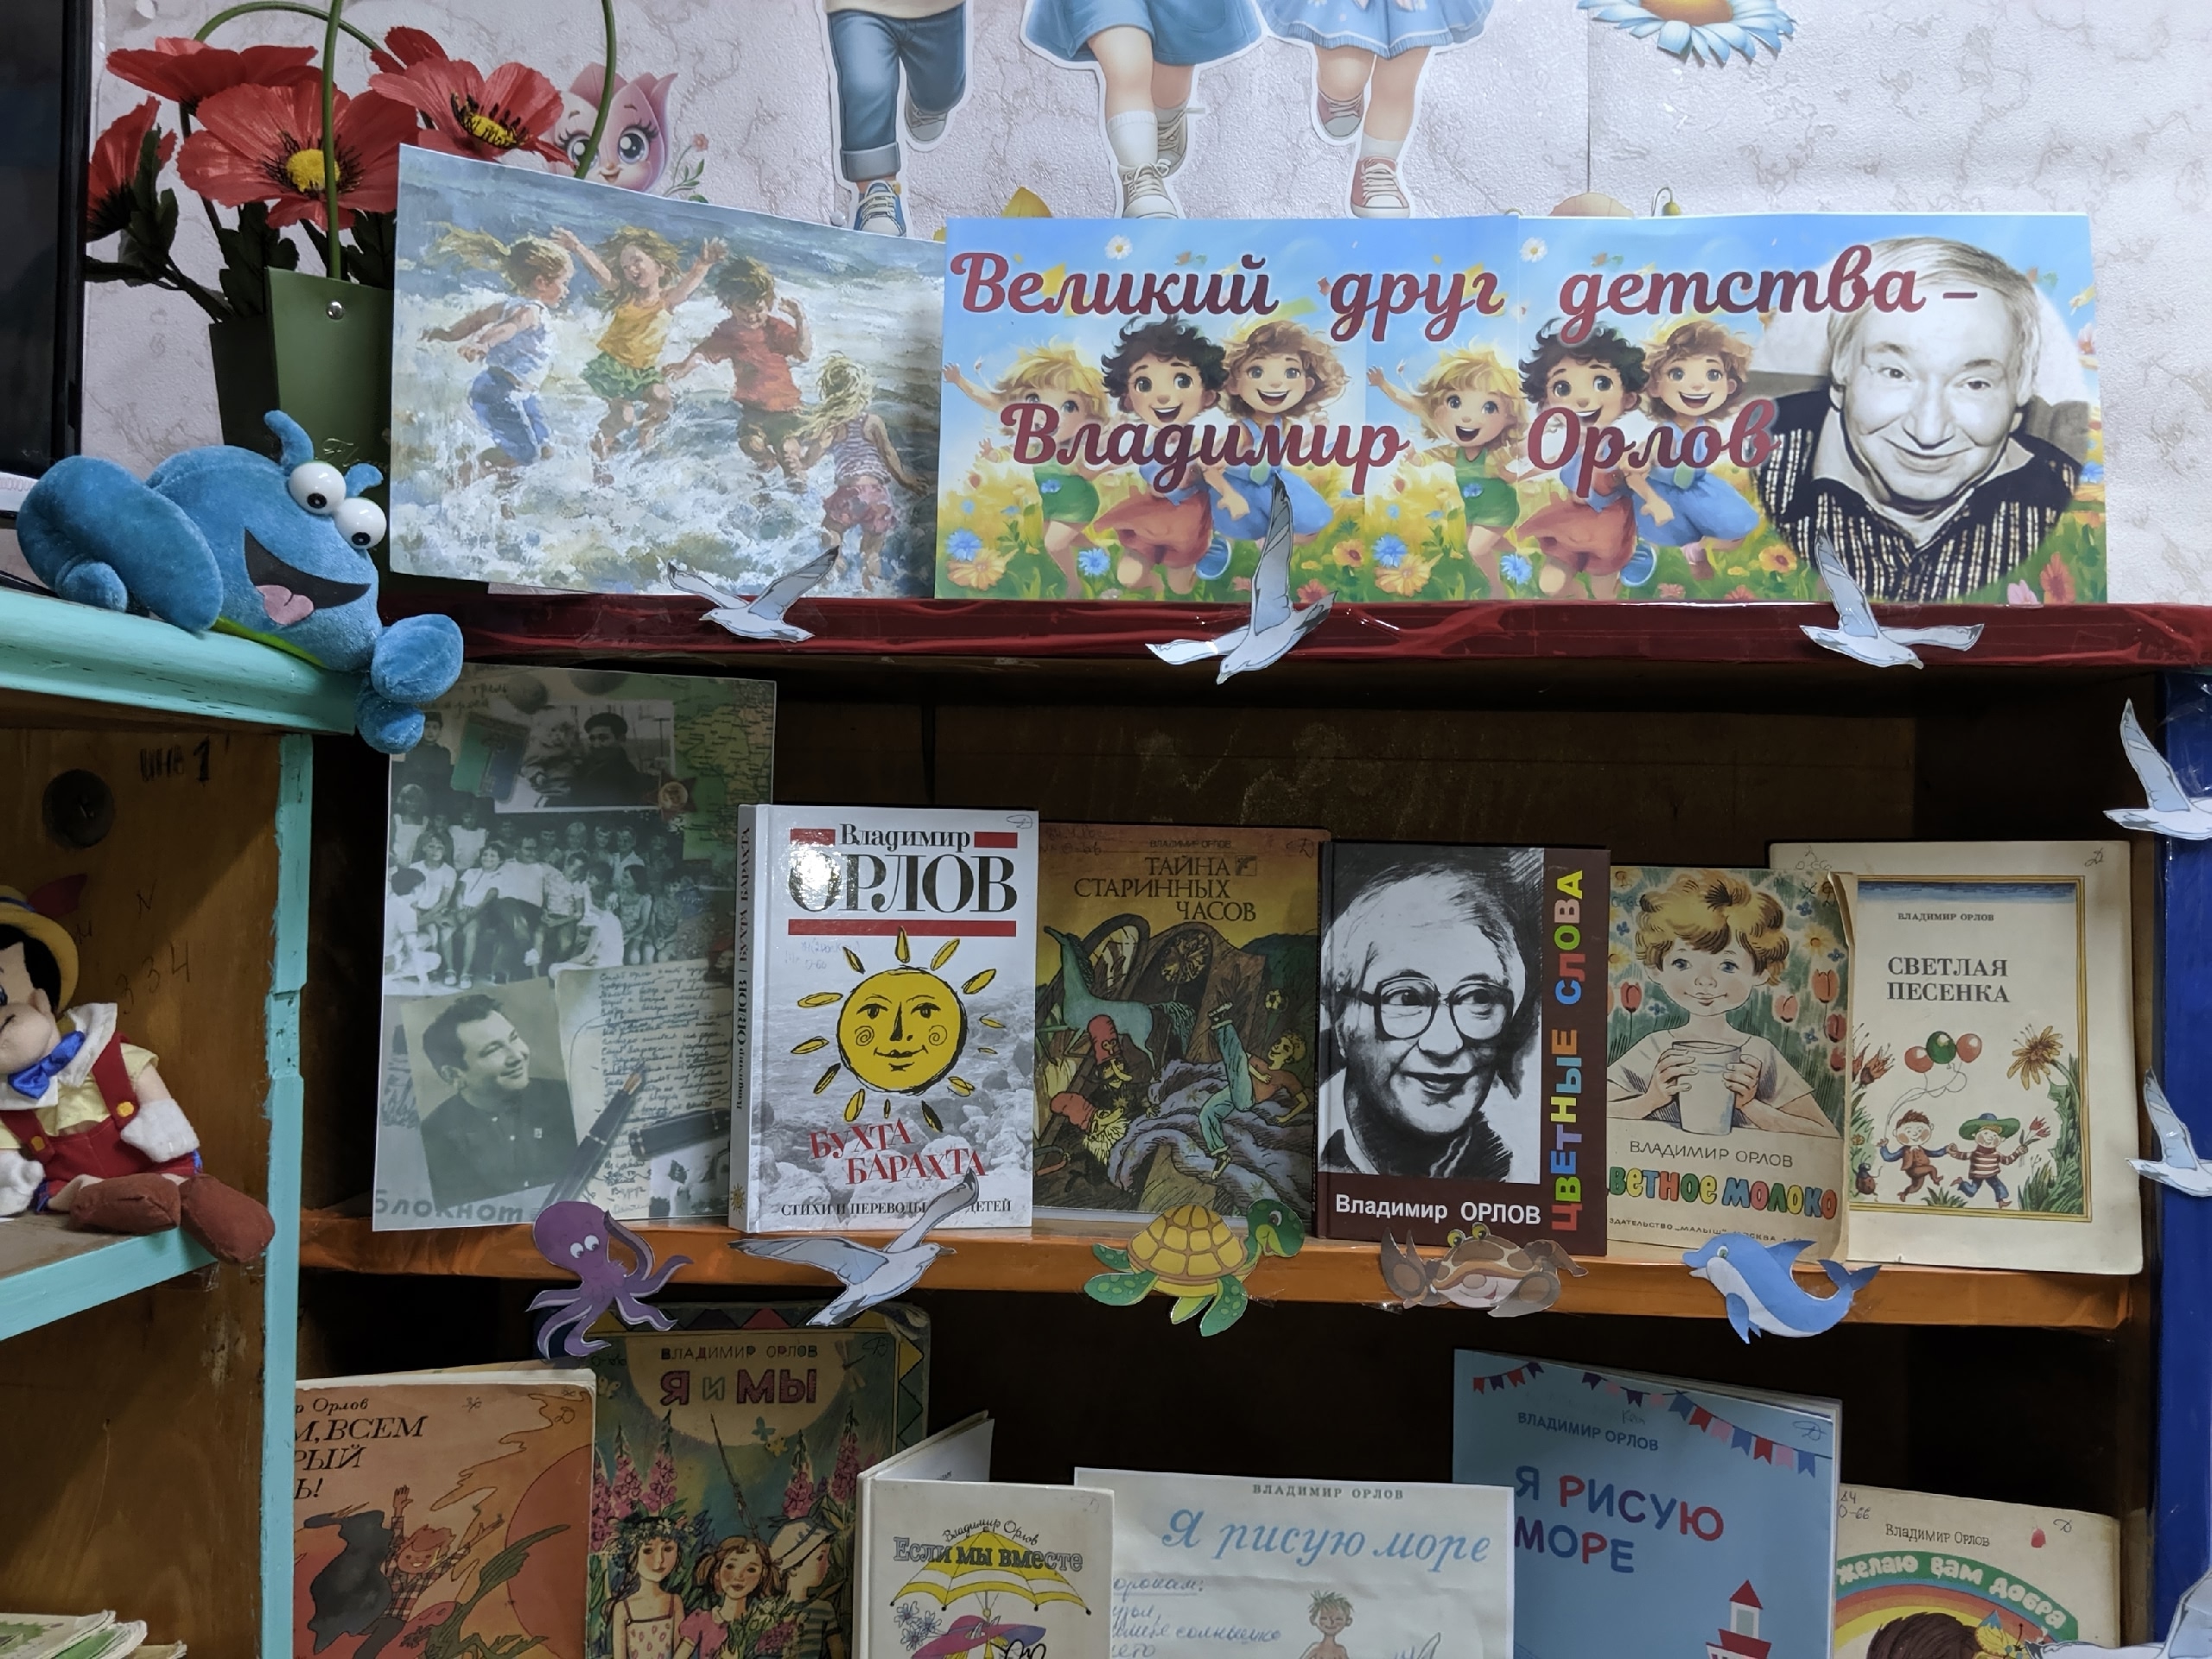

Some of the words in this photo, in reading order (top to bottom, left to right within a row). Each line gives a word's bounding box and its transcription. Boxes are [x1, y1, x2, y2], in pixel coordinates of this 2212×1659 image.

[950, 252, 1280, 316] Великий
[1330, 271, 1506, 342] друг
[1559, 245, 1927, 346] детства
[1001, 403, 1410, 495] Владимир
[1527, 397, 1782, 498] Орлов
[839, 823, 970, 853] Владимир
[741, 827, 750, 901] БАРАХТА
[1145, 855, 1231, 876] ТАЙНА
[788, 854, 1018, 912] ОРЛОВ
[1074, 878, 1230, 899] СТАРИННЫХ
[1176, 901, 1257, 922] ЧАСОВ
[1897, 912, 1957, 922] ВЛАДИМИР
[1960, 913, 1994, 922] ОРЛОВ
[739, 910, 748, 962] БУХТА
[1554, 869, 1586, 1006] СЛОВА
[1887, 957, 2009, 977] СВЕТЛАЯ
[1887, 982, 2011, 1003] ПЕСЕНКА
[736, 980, 747, 1046] ОРЛОВ
[809, 1118, 914, 1160] БУХТА
[1551, 1028, 1583, 1232] ЦВЕТНЫЕ
[845, 1147, 989, 1185] БАРАХТА
[1630, 1141, 1730, 1160] ВЛАДИМИР
[1735, 1150, 1794, 1168] ОРЛОВ
[1606, 1166, 1718, 1205] ветное
[781, 1204, 831, 1216] СТИХИ
[837, 1203, 846, 1215] И
[850, 1201, 927, 1215] ПЕРЕВОДЫ
[1335, 1193, 1449, 1224] Владимир
[1460, 1201, 1541, 1224] ОРЛОВ
[1609, 1217, 1674, 1230] ЗДАТЕЛЬСТВО
[661, 1344, 757, 1361] ВЛАДИМИР
[766, 1344, 818, 1358] ОРЛОВ
[660, 1370, 691, 1406] Я
[736, 1369, 817, 1404] МЫ
[312, 1397, 370, 1416] Орлов
[323, 1415, 429, 1441] ВСЕМ
[1517, 1412, 1601, 1439] ВЛАДИМИР
[1605, 1429, 1659, 1452] ОРЛОВ
[295, 1444, 367, 1471] РЫЙ
[1252, 1484, 1343, 1499] ВЛАДИМИР
[1351, 1488, 1404, 1500] ОРЛОВ
[1516, 1465, 1541, 1501] Я
[1559, 1474, 1725, 1541] РИСУЮ
[942, 1518, 1001, 1542] Владимир
[1003, 1520, 1039, 1546] Орлов
[1161, 1509, 1205, 1548] Я
[1214, 1521, 1366, 1567] рисую
[1372, 1531, 1491, 1573] море
[1514, 1516, 1635, 1573] МОРЕ
[1885, 1523, 1951, 1544] Владимир
[1954, 1531, 1991, 1548] Орлов
[893, 1536, 953, 1564] Если
[956, 1547, 993, 1567] мы
[998, 1548, 1084, 1573] вместе
